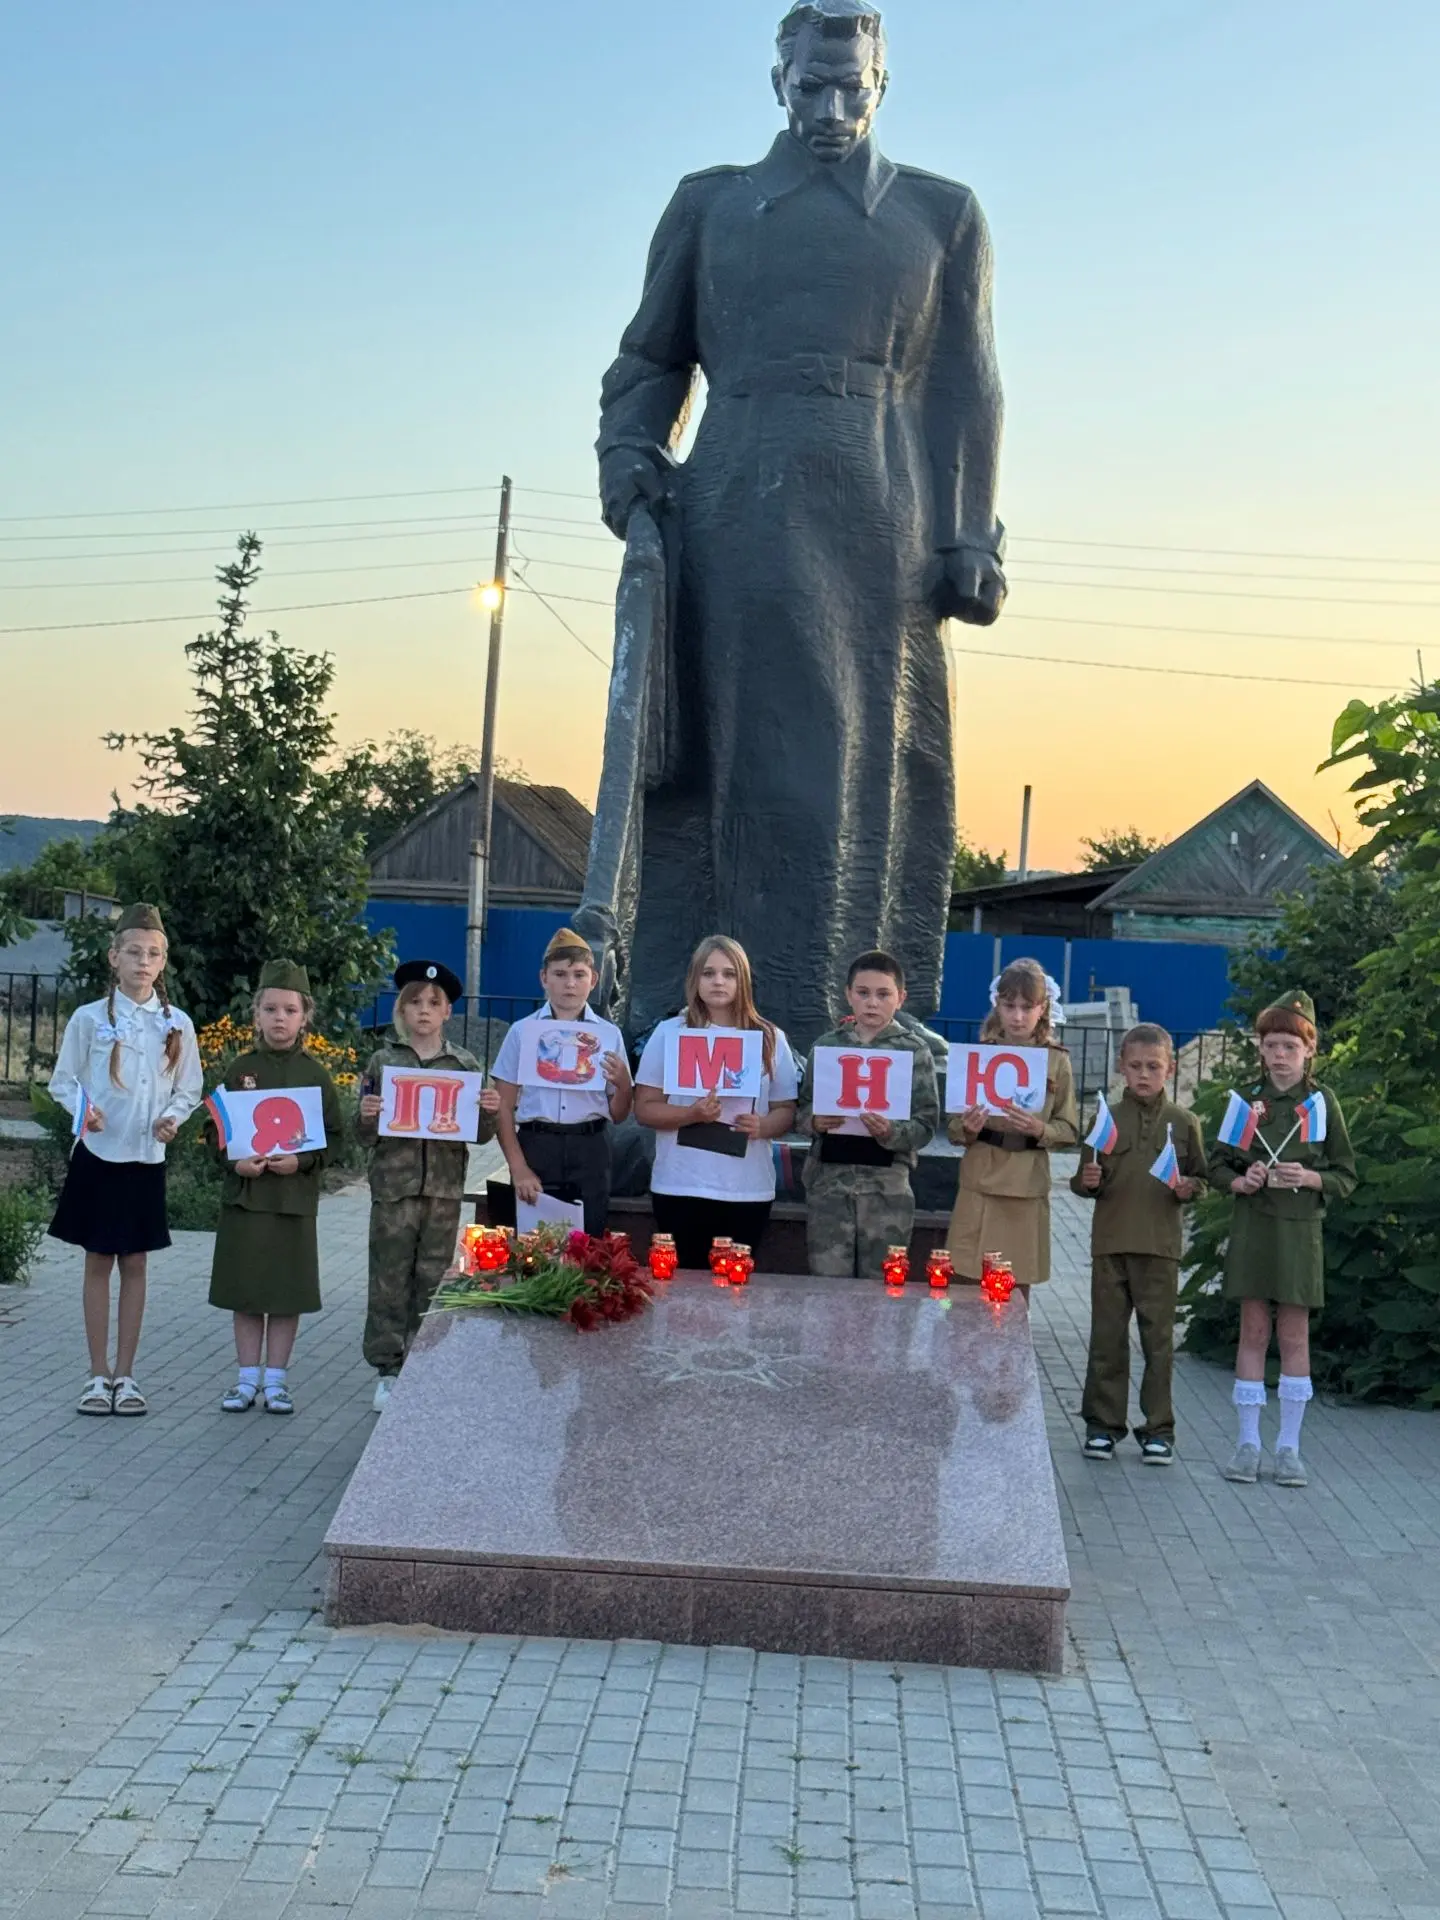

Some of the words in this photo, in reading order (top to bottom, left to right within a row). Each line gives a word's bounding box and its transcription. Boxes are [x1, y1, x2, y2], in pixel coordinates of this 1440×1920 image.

[678, 1036, 743, 1089] М
[836, 1054, 892, 1110] Н
[965, 1051, 1029, 1108] Ю
[251, 1096, 305, 1155] Я
[387, 1074, 465, 1133] П
